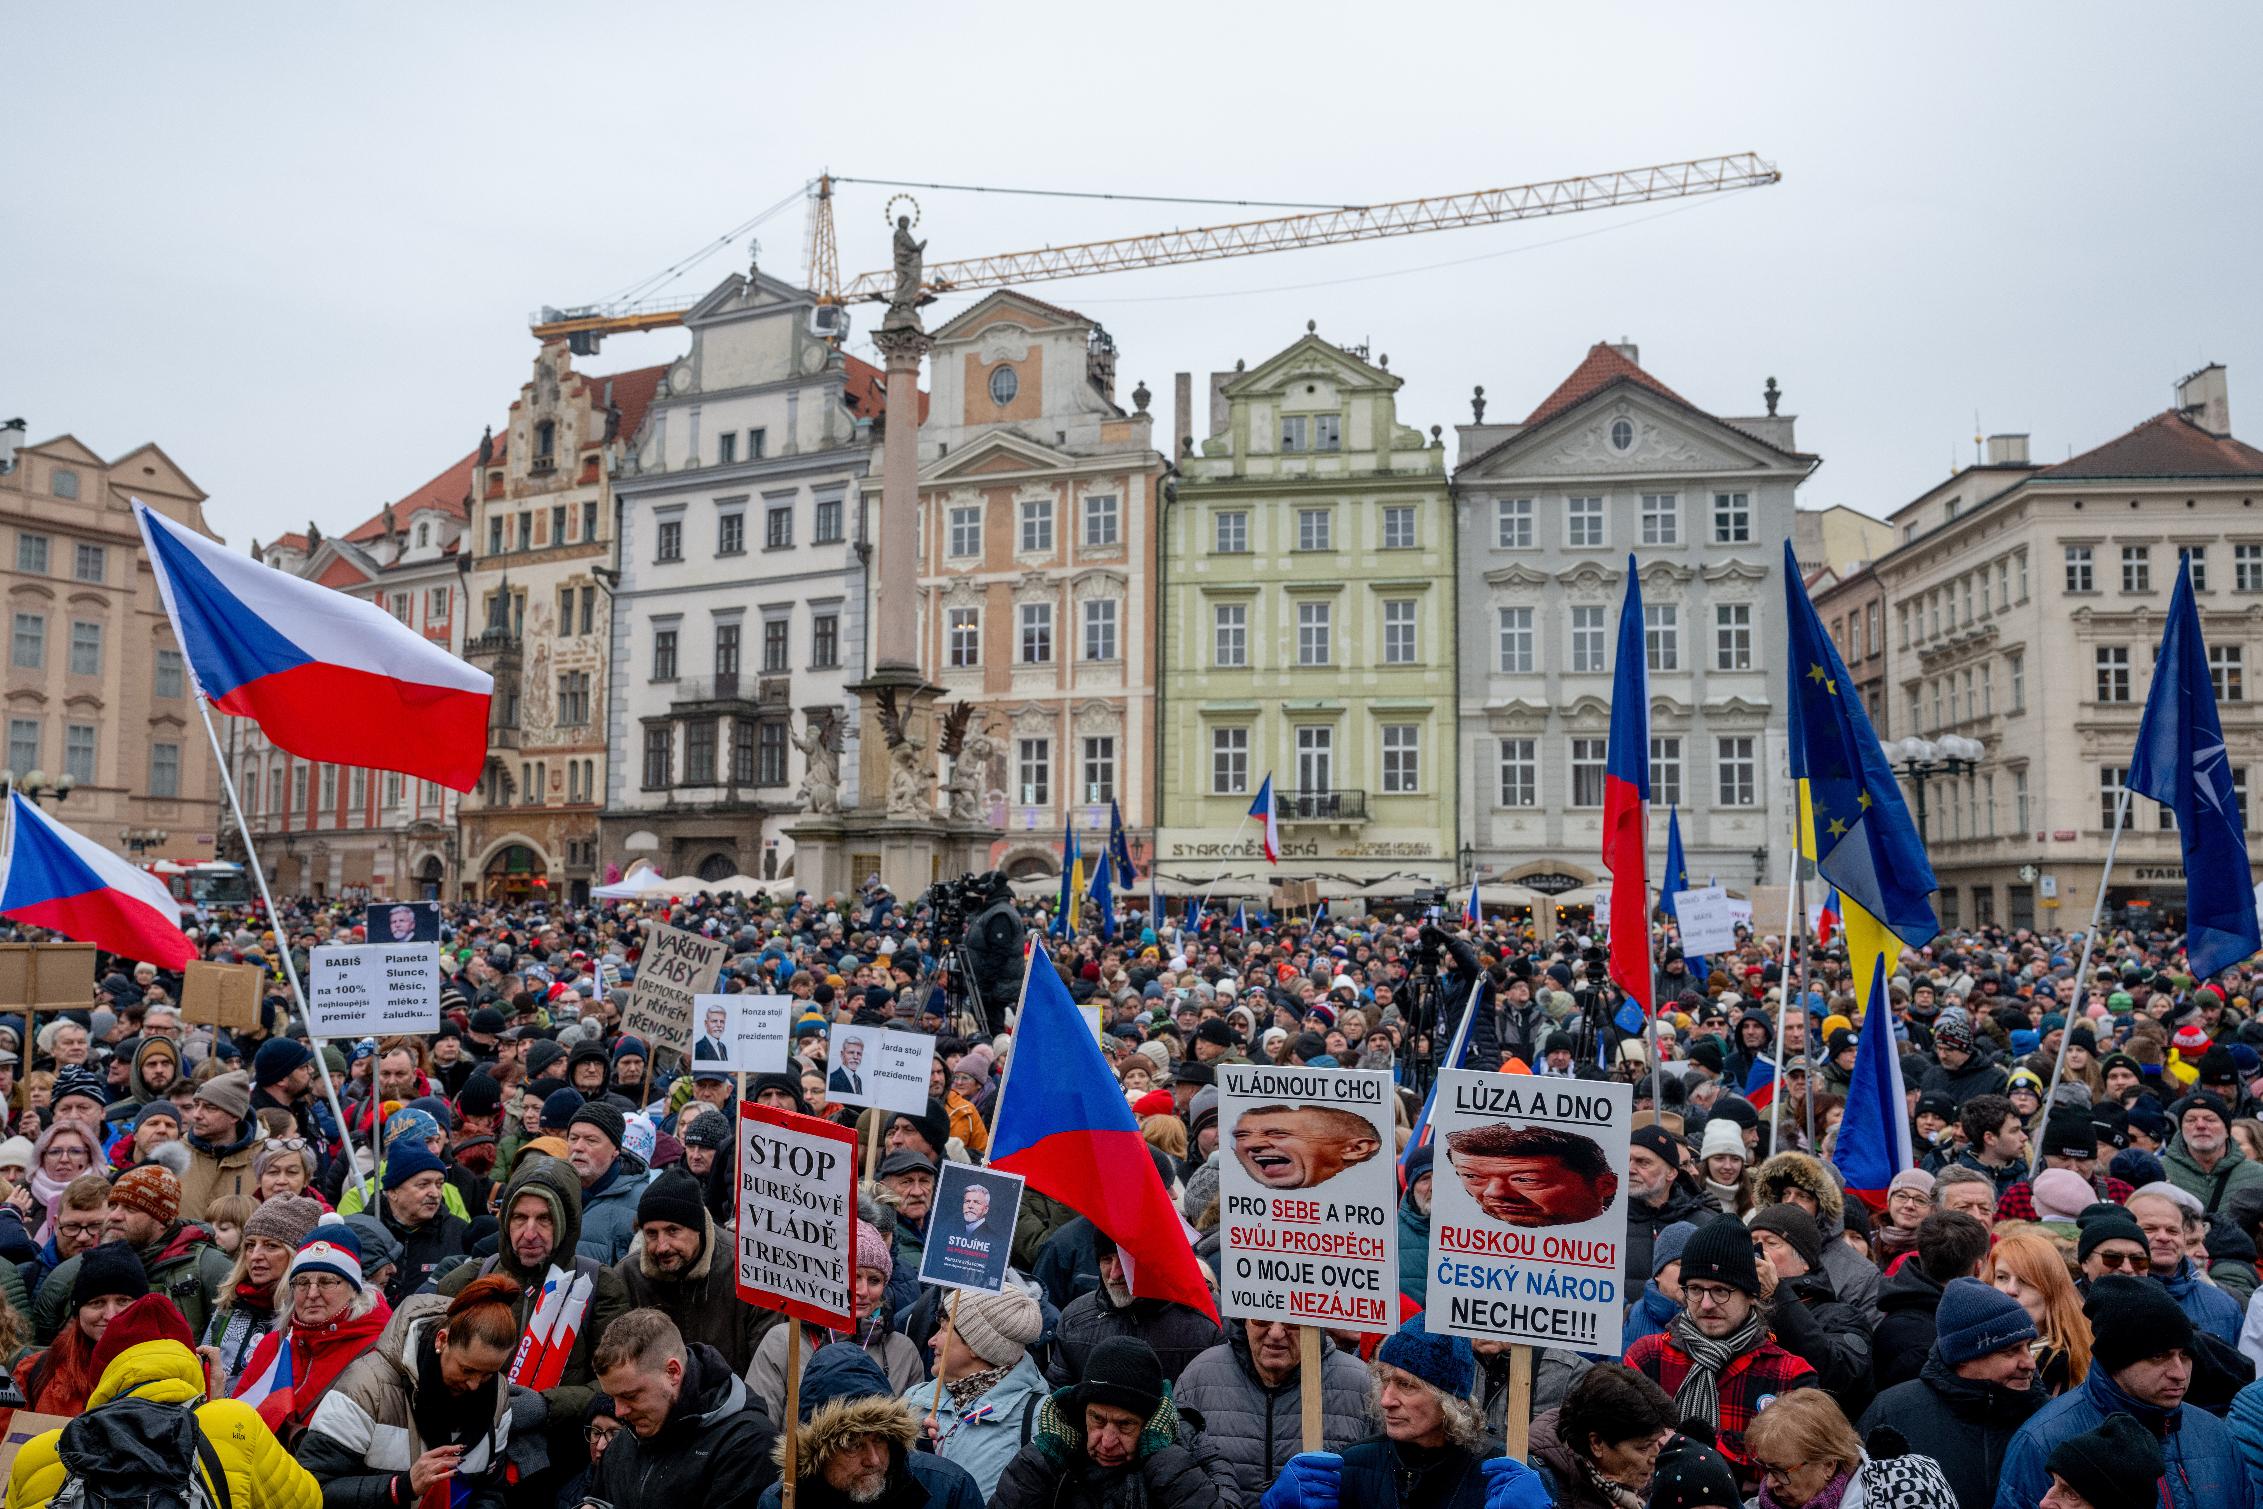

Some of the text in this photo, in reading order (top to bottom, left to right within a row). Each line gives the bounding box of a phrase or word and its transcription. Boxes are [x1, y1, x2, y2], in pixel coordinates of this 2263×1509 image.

[1172, 837, 1318, 856] STAROMĚSSKÁ
[325, 957, 361, 967] BABIŠ
[385, 954, 428, 964] Planeta
[657, 930, 720, 965] VAŘENÍ
[338, 972, 348, 980] je
[386, 969, 428, 978] Slunce,
[647, 952, 701, 987] ŽÁBY
[335, 984, 366, 994] 100%
[389, 982, 426, 991] Měsíc,
[632, 993, 642, 1007] V
[638, 976, 694, 1005] (DEMOKRAC
[387, 997, 419, 1006] mléko
[742, 1007, 783, 1017] Honza stojí
[321, 1011, 366, 1023] premiér
[627, 1012, 693, 1047] PŘENOSU!
[737, 1032, 784, 1041] prezidentem
[881, 1042, 922, 1056] Jarda stojí
[873, 1069, 923, 1083] prezidentem
[895, 1059, 905, 1067] za
[1227, 1071, 1381, 1100] VLÁDNOUT CHCI
[1456, 1080, 1613, 1122] LŮZA A DNO
[750, 1134, 836, 1182] STOP
[743, 1172, 844, 1217] BUREŠOVĚ
[1229, 1195, 1385, 1226] PRO SEBE A PRO
[748, 1203, 838, 1251] VLÁDĚ
[1230, 1222, 1385, 1258] SVŮJ PROSPĚCH
[948, 1235, 991, 1252] STOJÍME
[1440, 1225, 1616, 1265] RUSKOU ONUCI
[740, 1236, 844, 1285] TRESTNĚ
[1236, 1257, 1380, 1291] O MOJE OVCE
[741, 1263, 853, 1311] STÍHANÝCH!
[1437, 1256, 1616, 1303] ČESKÝ NÁROD
[1231, 1289, 1386, 1321] VOLIČE NEZÁJEM
[1451, 1296, 1597, 1340] NECHCE!!!
